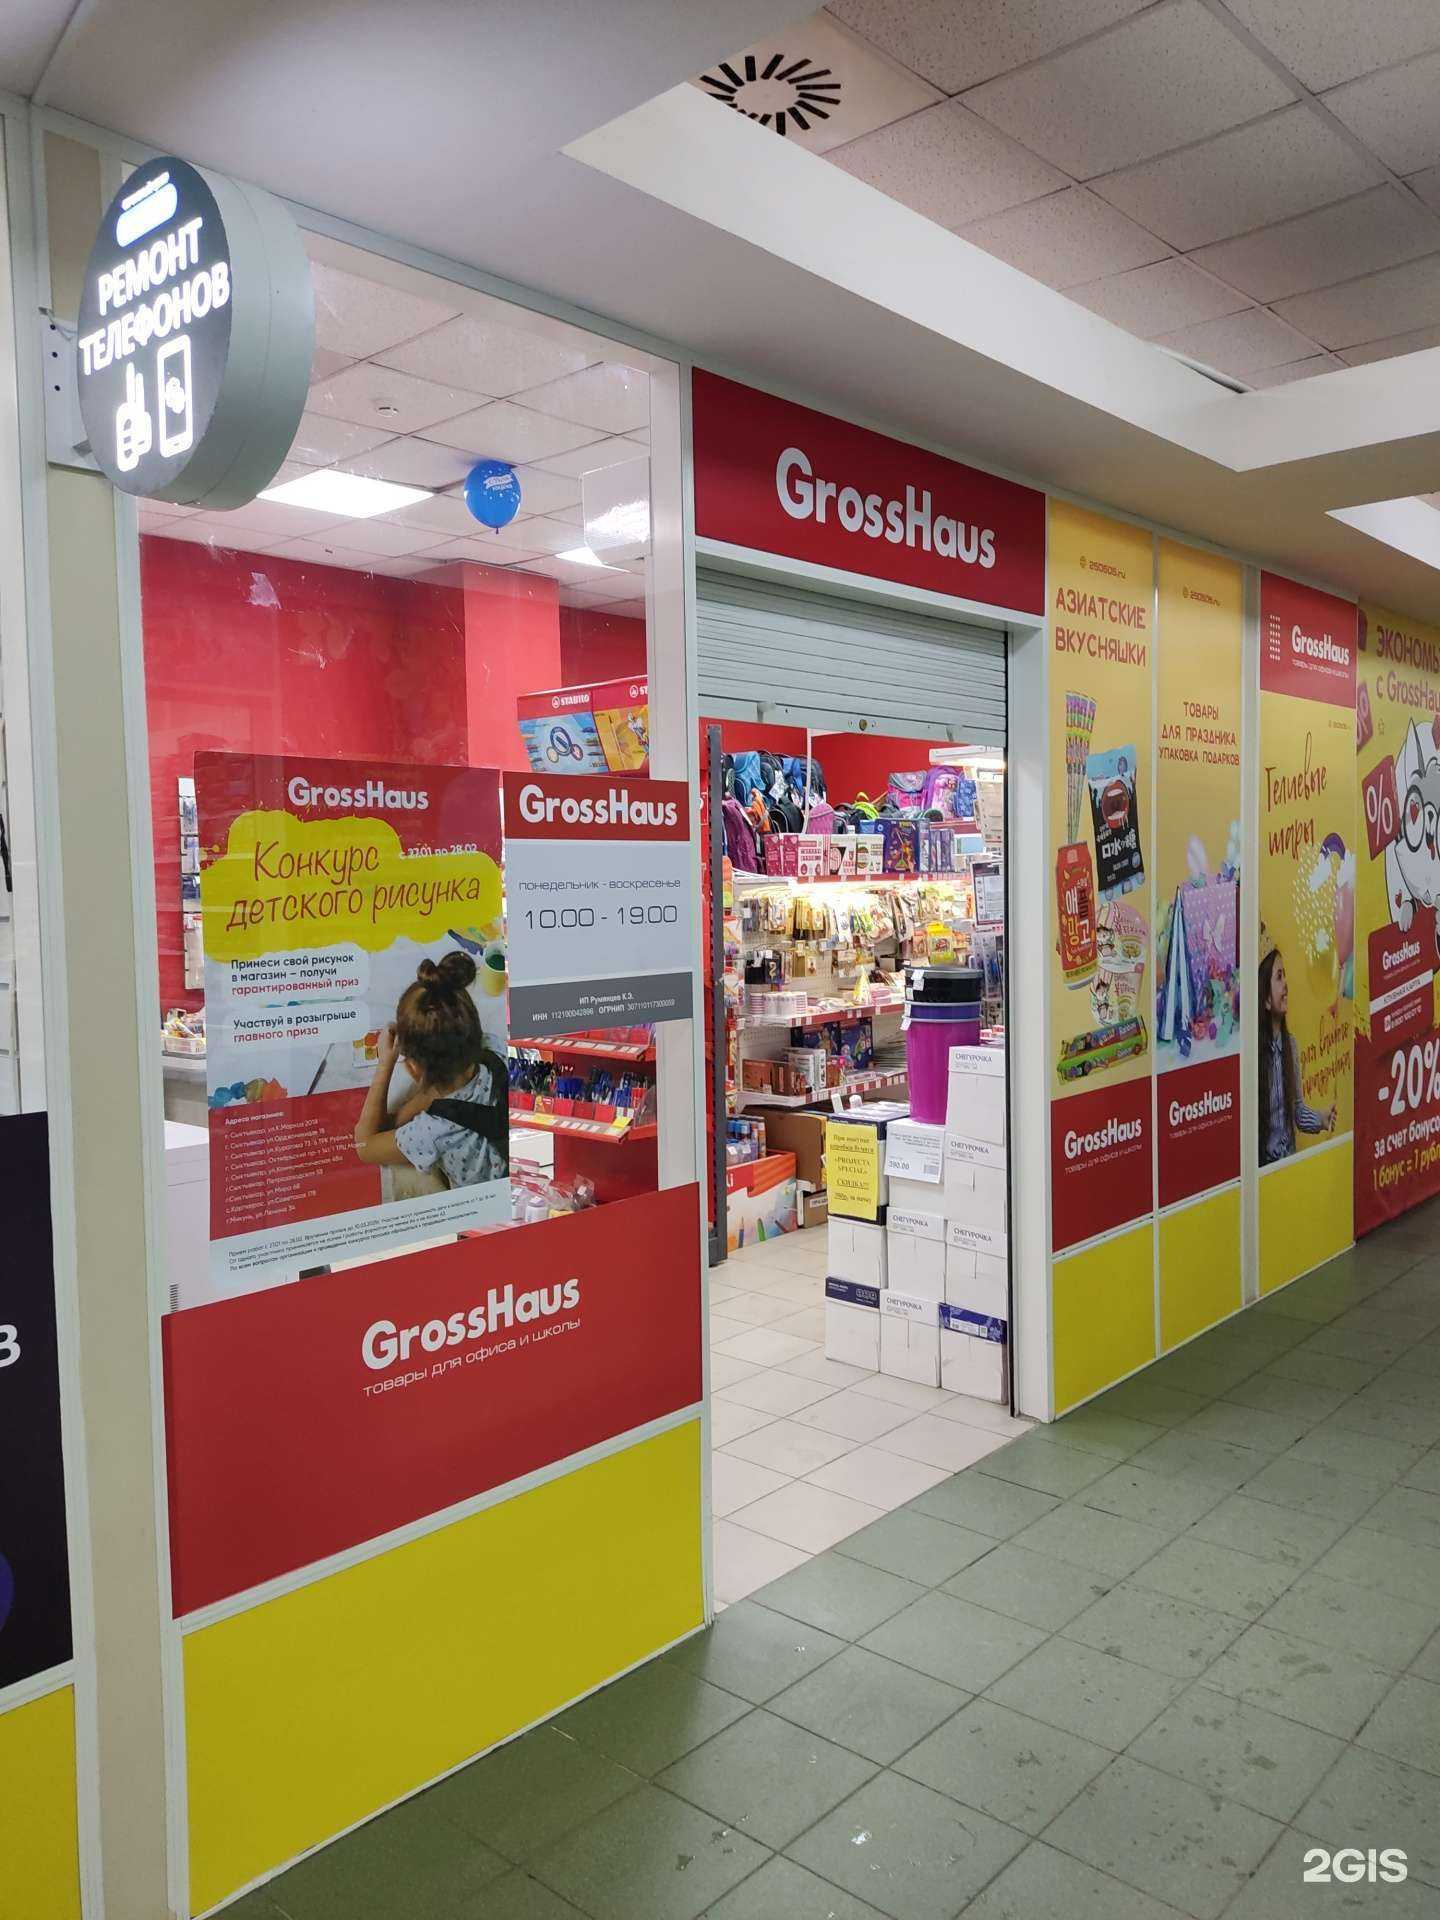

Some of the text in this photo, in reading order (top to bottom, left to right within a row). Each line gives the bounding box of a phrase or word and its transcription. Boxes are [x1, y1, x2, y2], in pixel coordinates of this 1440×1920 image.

[97, 216, 203, 316] РЕМОНТ
[79, 262, 230, 376] ТЕЛЕФОНОВ
[776, 447, 996, 569] GrossHaus
[1056, 587, 1146, 629] АЗИАТСКИЕ
[1056, 626, 1146, 667] ВКУСНЯШКИ
[1291, 625, 1350, 666] GrossHaus
[1376, 625, 1440, 674] ЭКОНОМЬ
[560, 694, 590, 707] STABILO
[1183, 701, 1219, 720] ТОВАРЫ
[1387, 670, 1440, 712] GrossHau
[1162, 724, 1181, 739] ДЛЯ
[1159, 746, 1240, 766] УПАКОВКА ПОДАРКОВ
[1264, 731, 1327, 813] Гелиевые
[288, 776, 429, 810] GrossHaus
[518, 783, 679, 827] GrossHaus
[254, 840, 379, 886] Конкурс
[226, 877, 480, 931] детского рисунка
[519, 880, 600, 892] понедельник
[609, 879, 681, 891] воскресенье
[525, 908, 595, 930] 10.00
[617, 905, 678, 925] 19.00
[231, 953, 354, 970] Принеси свой рисунок
[231, 974, 238, 982] в
[240, 972, 287, 982] магазин
[300, 968, 337, 981] получи
[1383, 941, 1420, 970] GrossHaus
[232, 978, 359, 996] гарантированный приз
[579, 997, 589, 1005] ИП
[233, 1010, 357, 1030] Участвуй в розыгрыше
[532, 1011, 548, 1021] ИНН
[598, 1005, 625, 1014] ОГРНИП
[233, 1027, 319, 1043] главного приза
[1378, 1038, 1440, 1116] -20%
[1169, 1090, 1232, 1126] GrossHaus
[1064, 1118, 1142, 1159] GrossHaus
[1374, 1115, 1440, 1159] за счет бонусо
[1379, 1159, 1405, 1188] бонус
[1420, 1141, 1440, 1172] рубл
[362, 1278, 580, 1370] GrossHaus
[363, 1318, 581, 1397] товары для офиса и школы
